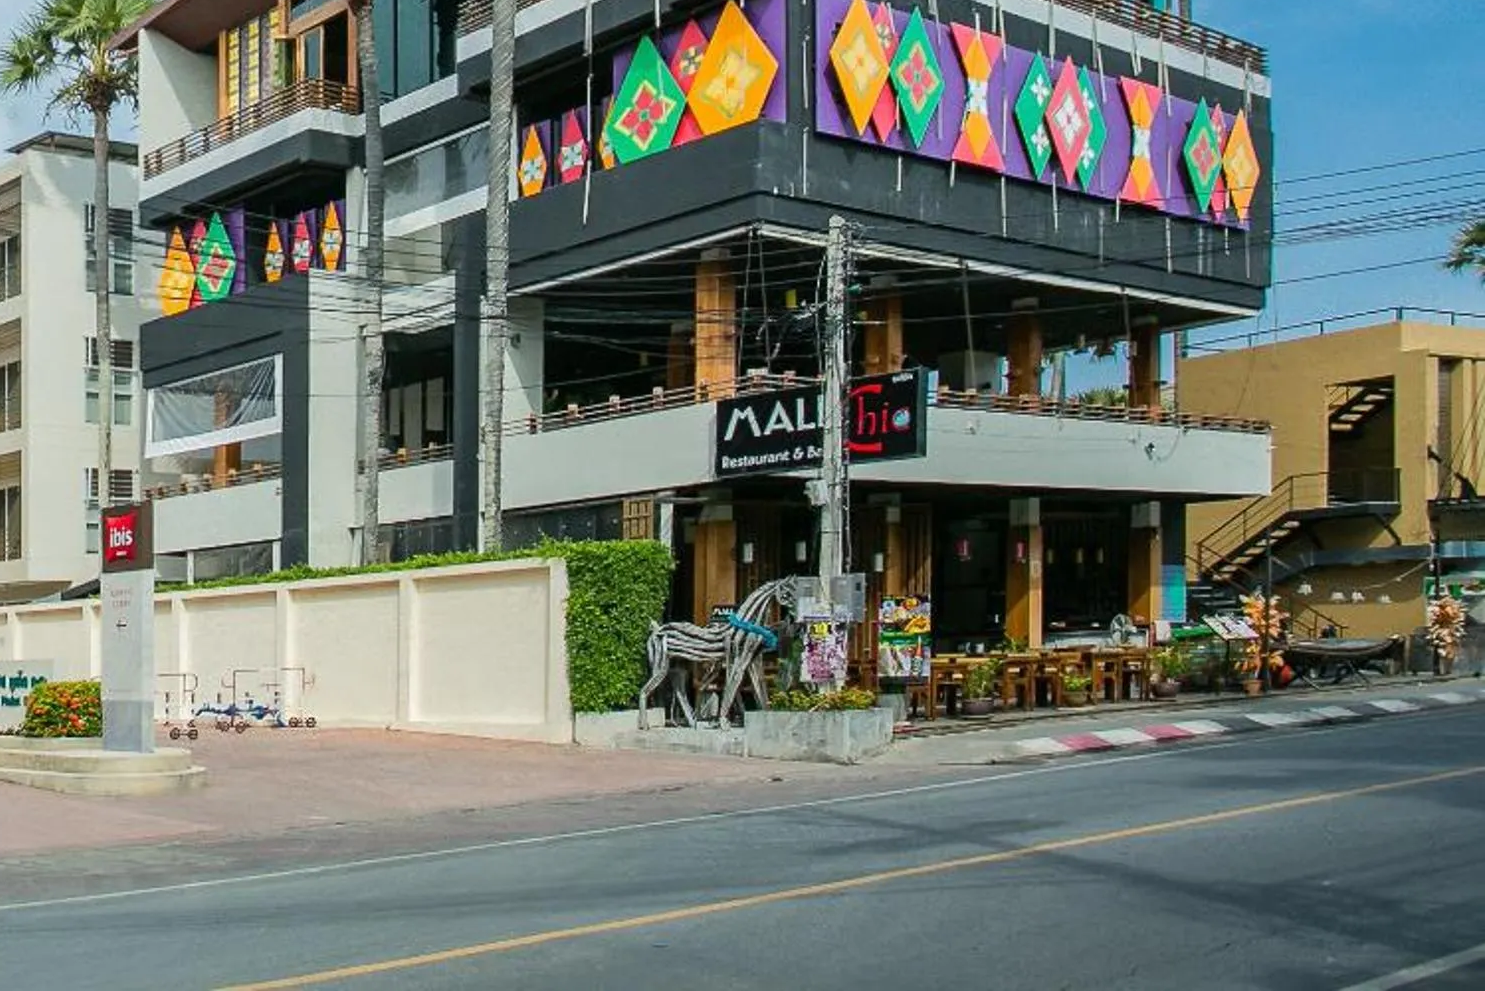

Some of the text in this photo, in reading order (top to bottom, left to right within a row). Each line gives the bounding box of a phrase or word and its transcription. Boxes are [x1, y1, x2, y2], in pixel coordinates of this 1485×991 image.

[721, 448, 791, 470] Restaurant
[793, 446, 804, 460] &
[109, 526, 133, 548] ibis
